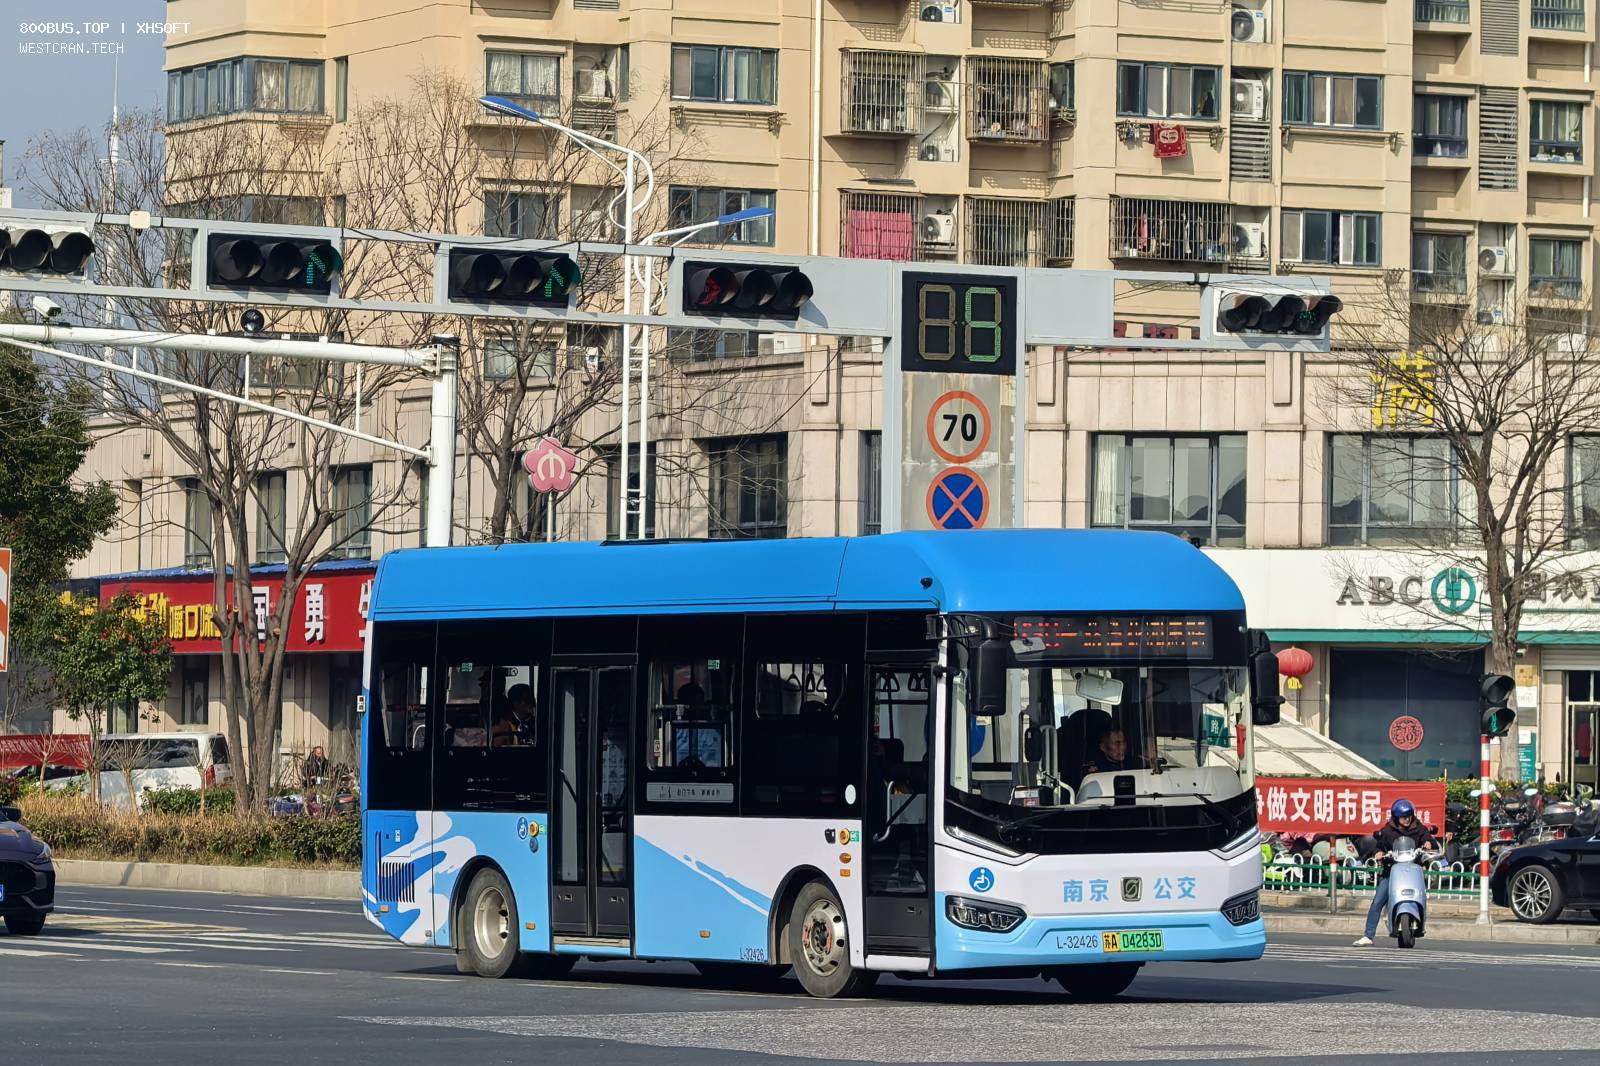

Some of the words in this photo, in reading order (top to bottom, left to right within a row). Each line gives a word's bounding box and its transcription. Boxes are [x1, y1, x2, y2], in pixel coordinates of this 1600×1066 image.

[942, 413, 977, 442] 70
[1336, 575, 1423, 606] ABC
[1062, 879, 1109, 903] 南京
[1153, 876, 1196, 900] 公交
[1056, 935, 1098, 949] L-32426
